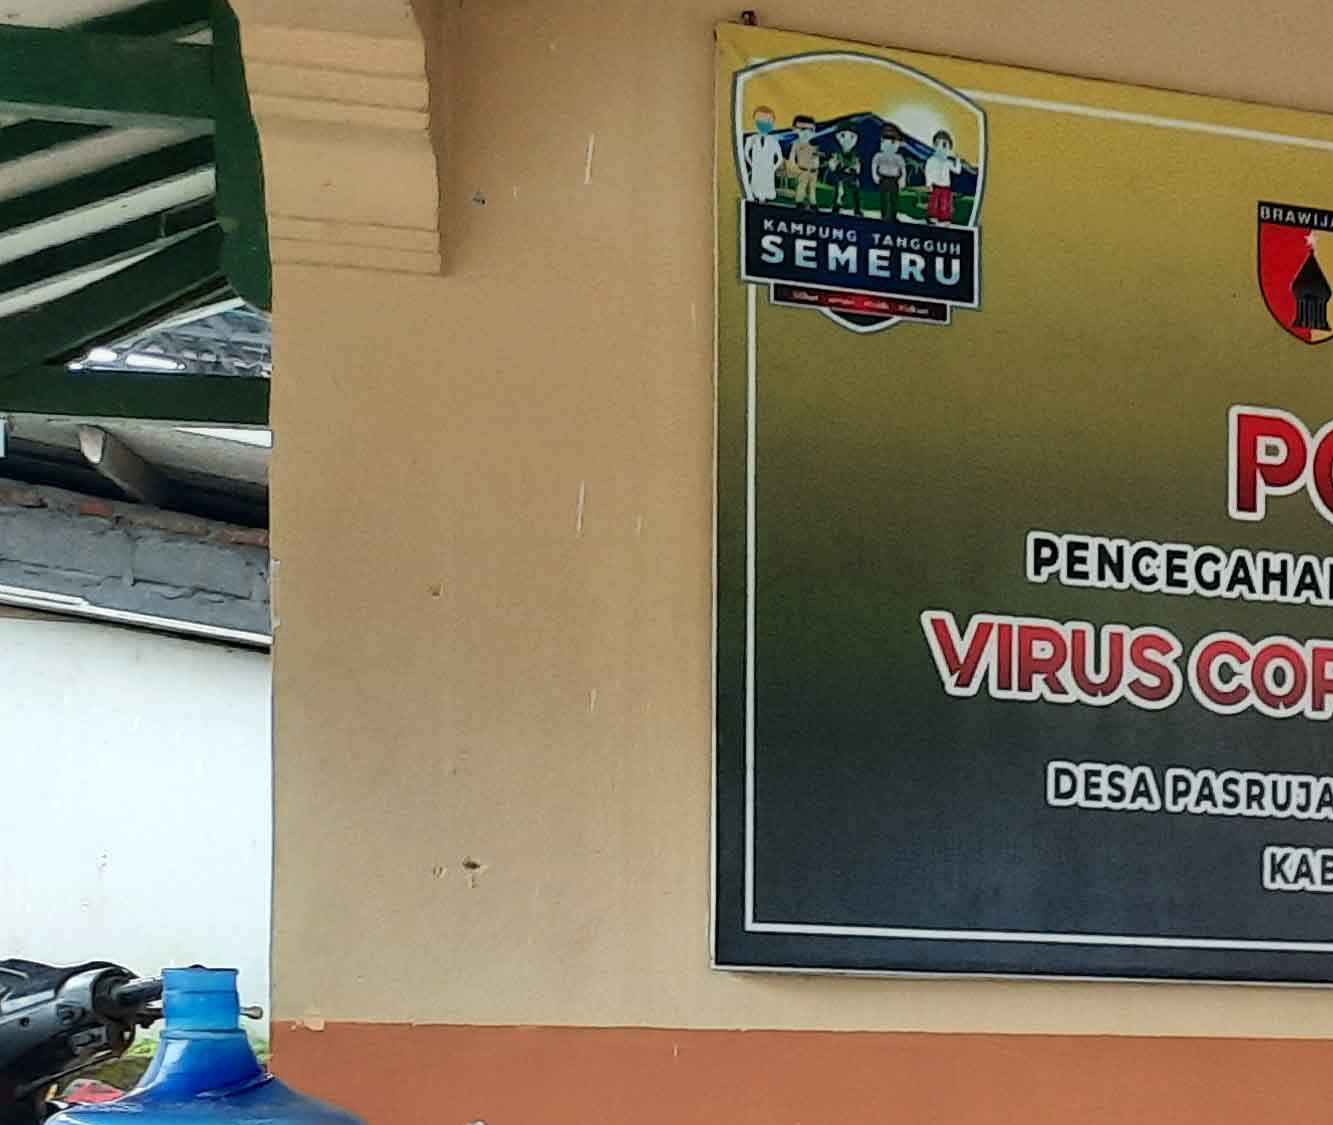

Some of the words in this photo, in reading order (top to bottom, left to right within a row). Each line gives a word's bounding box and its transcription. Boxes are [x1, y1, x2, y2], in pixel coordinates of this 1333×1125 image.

[761, 234, 962, 286] SEMERU
[763, 219, 857, 242] KAMPUNG
[872, 232, 961, 255] TANGGUH
[920, 610, 1183, 710] VIRUS
[1049, 762, 1160, 811] DESA
